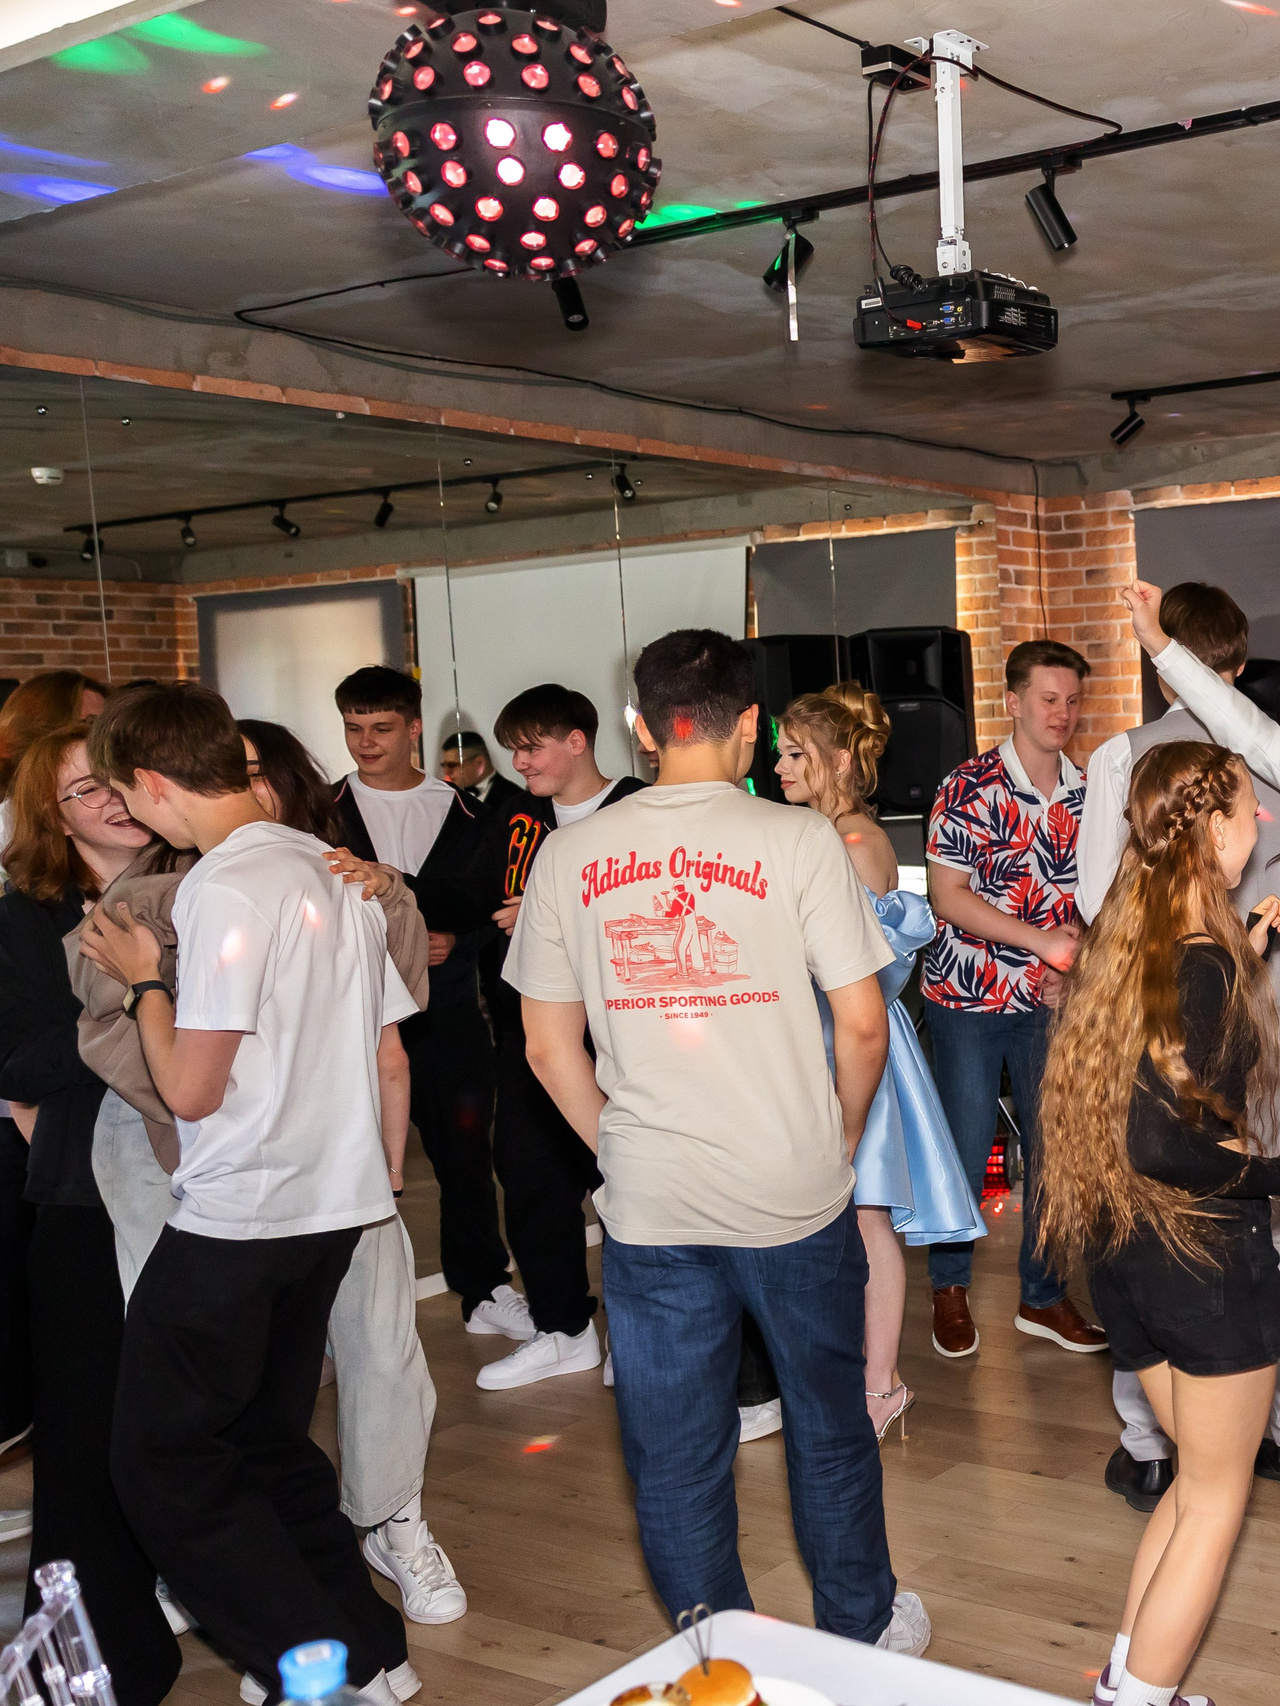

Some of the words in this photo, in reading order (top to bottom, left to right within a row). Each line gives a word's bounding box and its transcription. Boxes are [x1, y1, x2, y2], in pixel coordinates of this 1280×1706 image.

[581, 851, 662, 908] Adidas
[668, 846, 768, 900] Originals
[605, 996, 656, 1010] PERIOR
[659, 995, 727, 1008] SPORTING
[730, 990, 780, 1004] GOODS
[665, 1012, 688, 1020] SINCE
[690, 1011, 709, 1019] 1949
